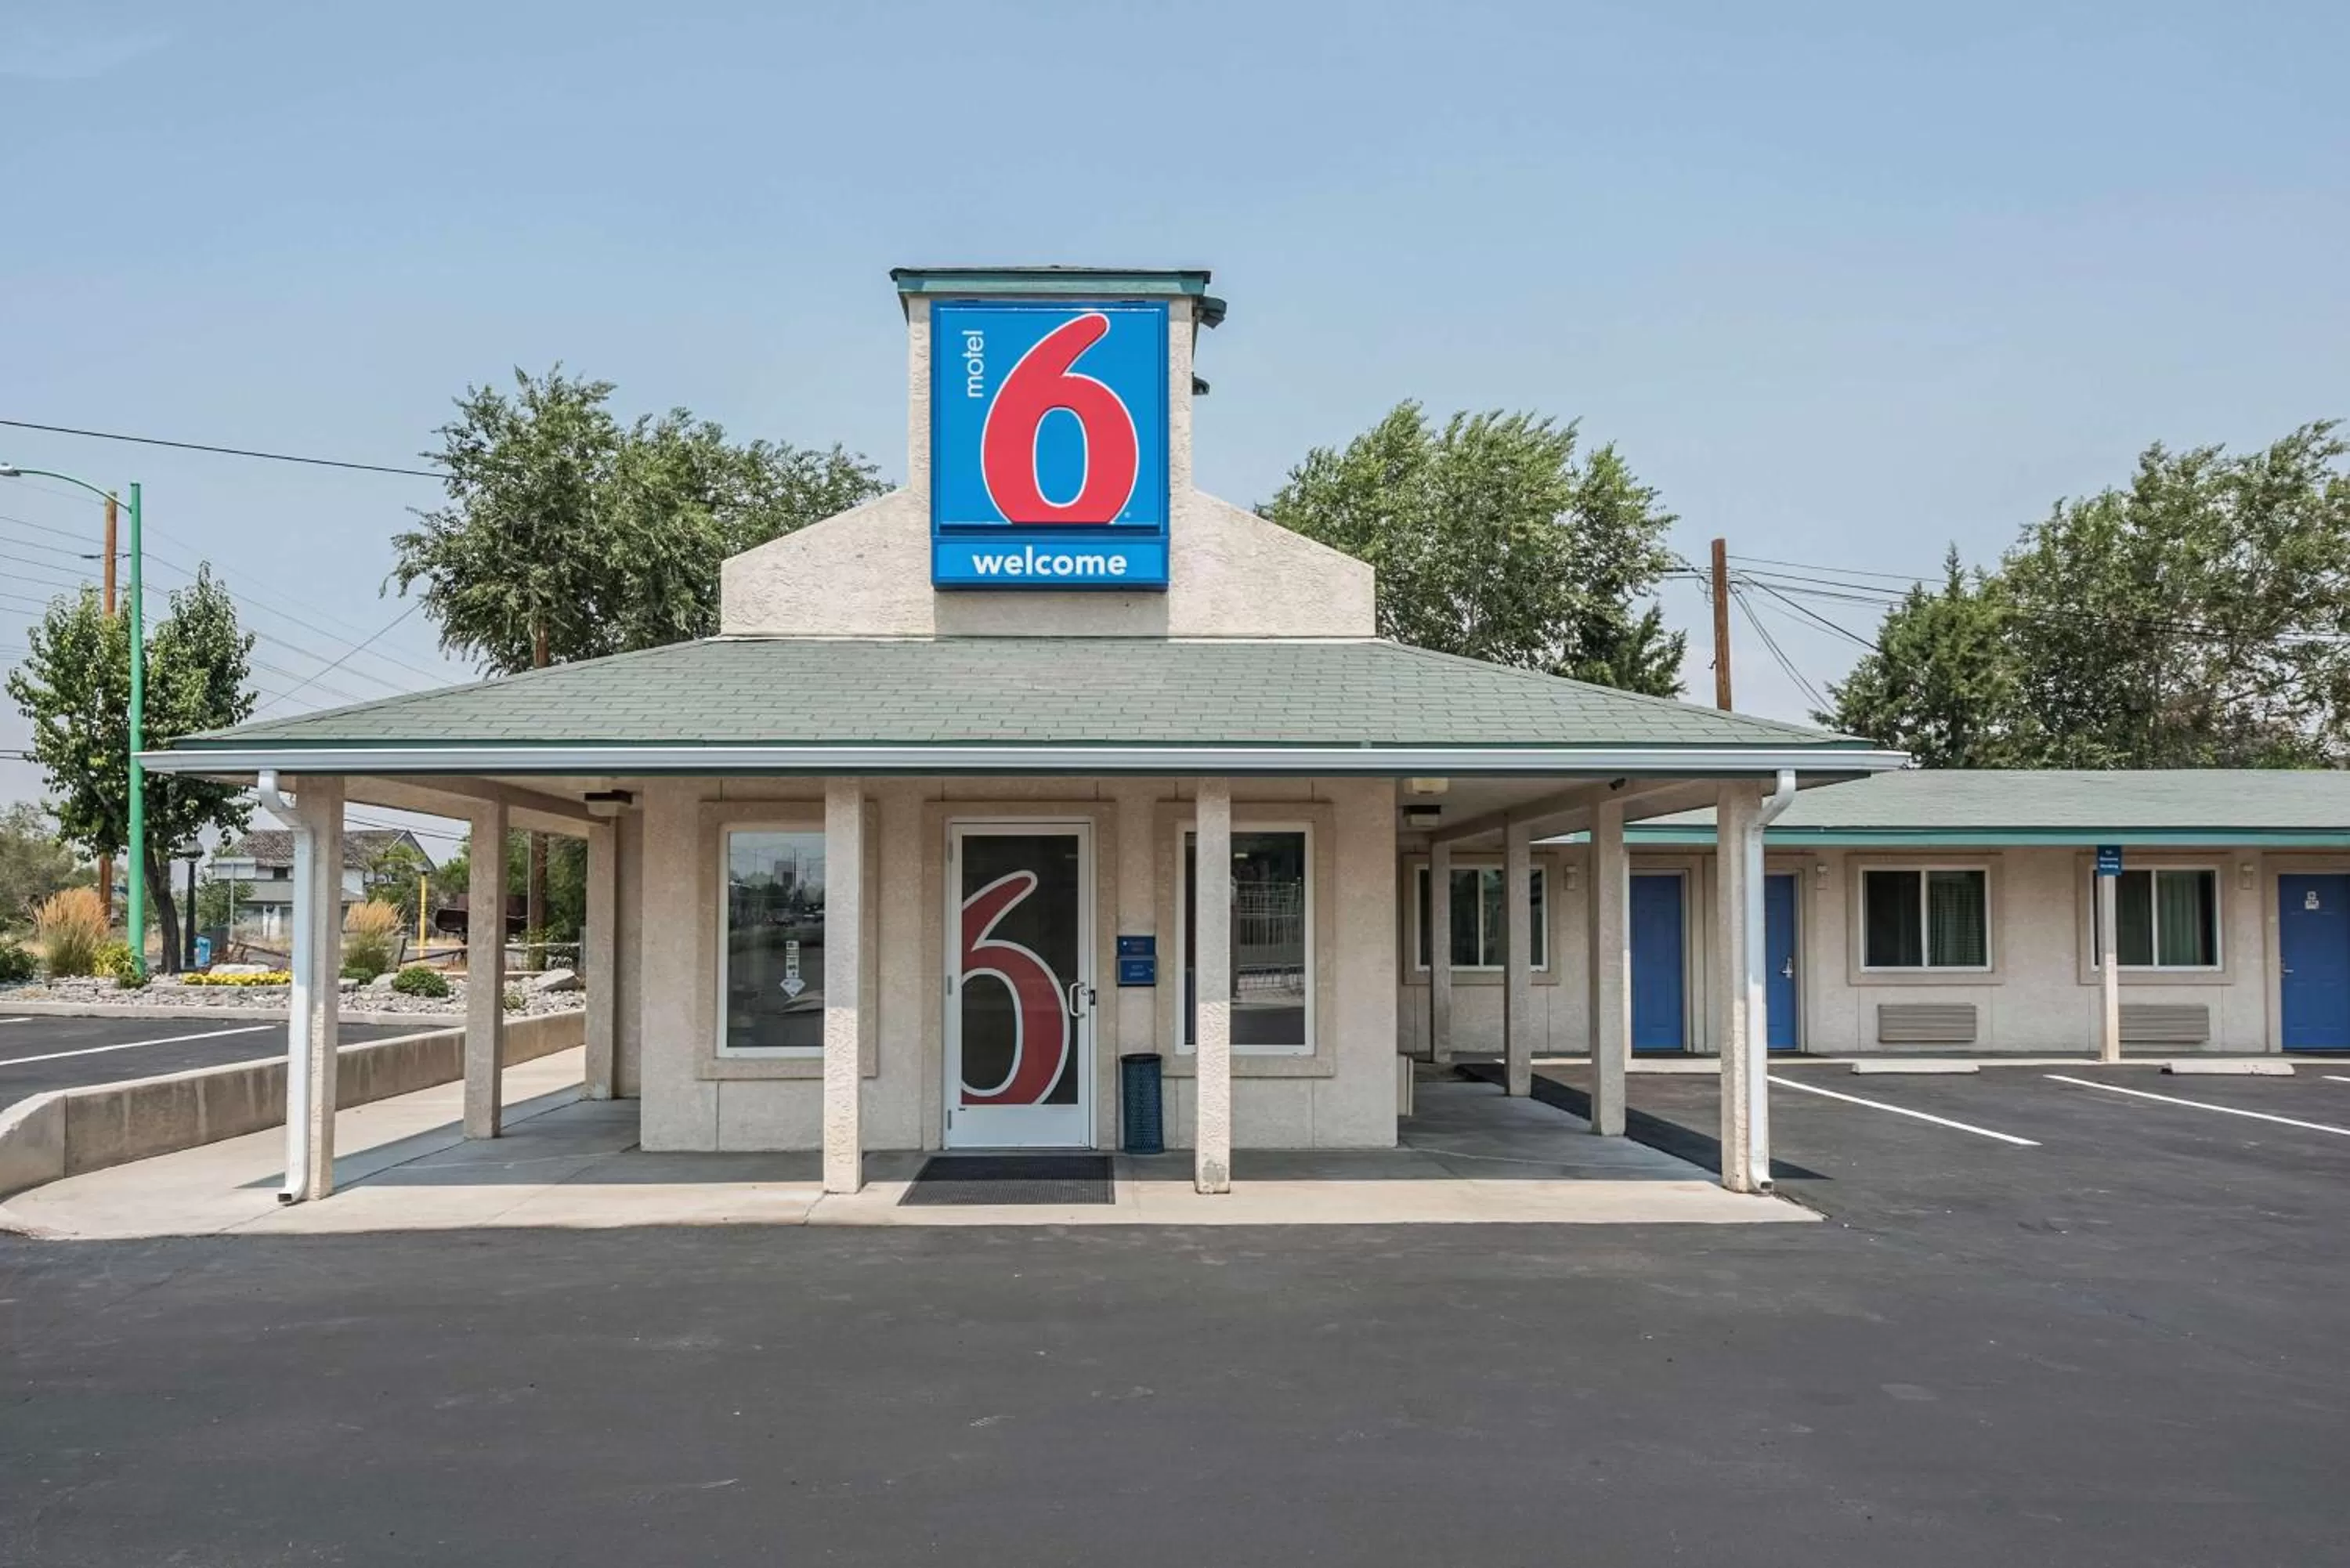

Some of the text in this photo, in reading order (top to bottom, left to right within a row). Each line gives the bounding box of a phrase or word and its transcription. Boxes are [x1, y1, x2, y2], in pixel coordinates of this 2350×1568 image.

[962, 313, 1140, 524] motel 6
[972, 545, 1127, 576] welcome
[961, 869, 1071, 1104] 6
